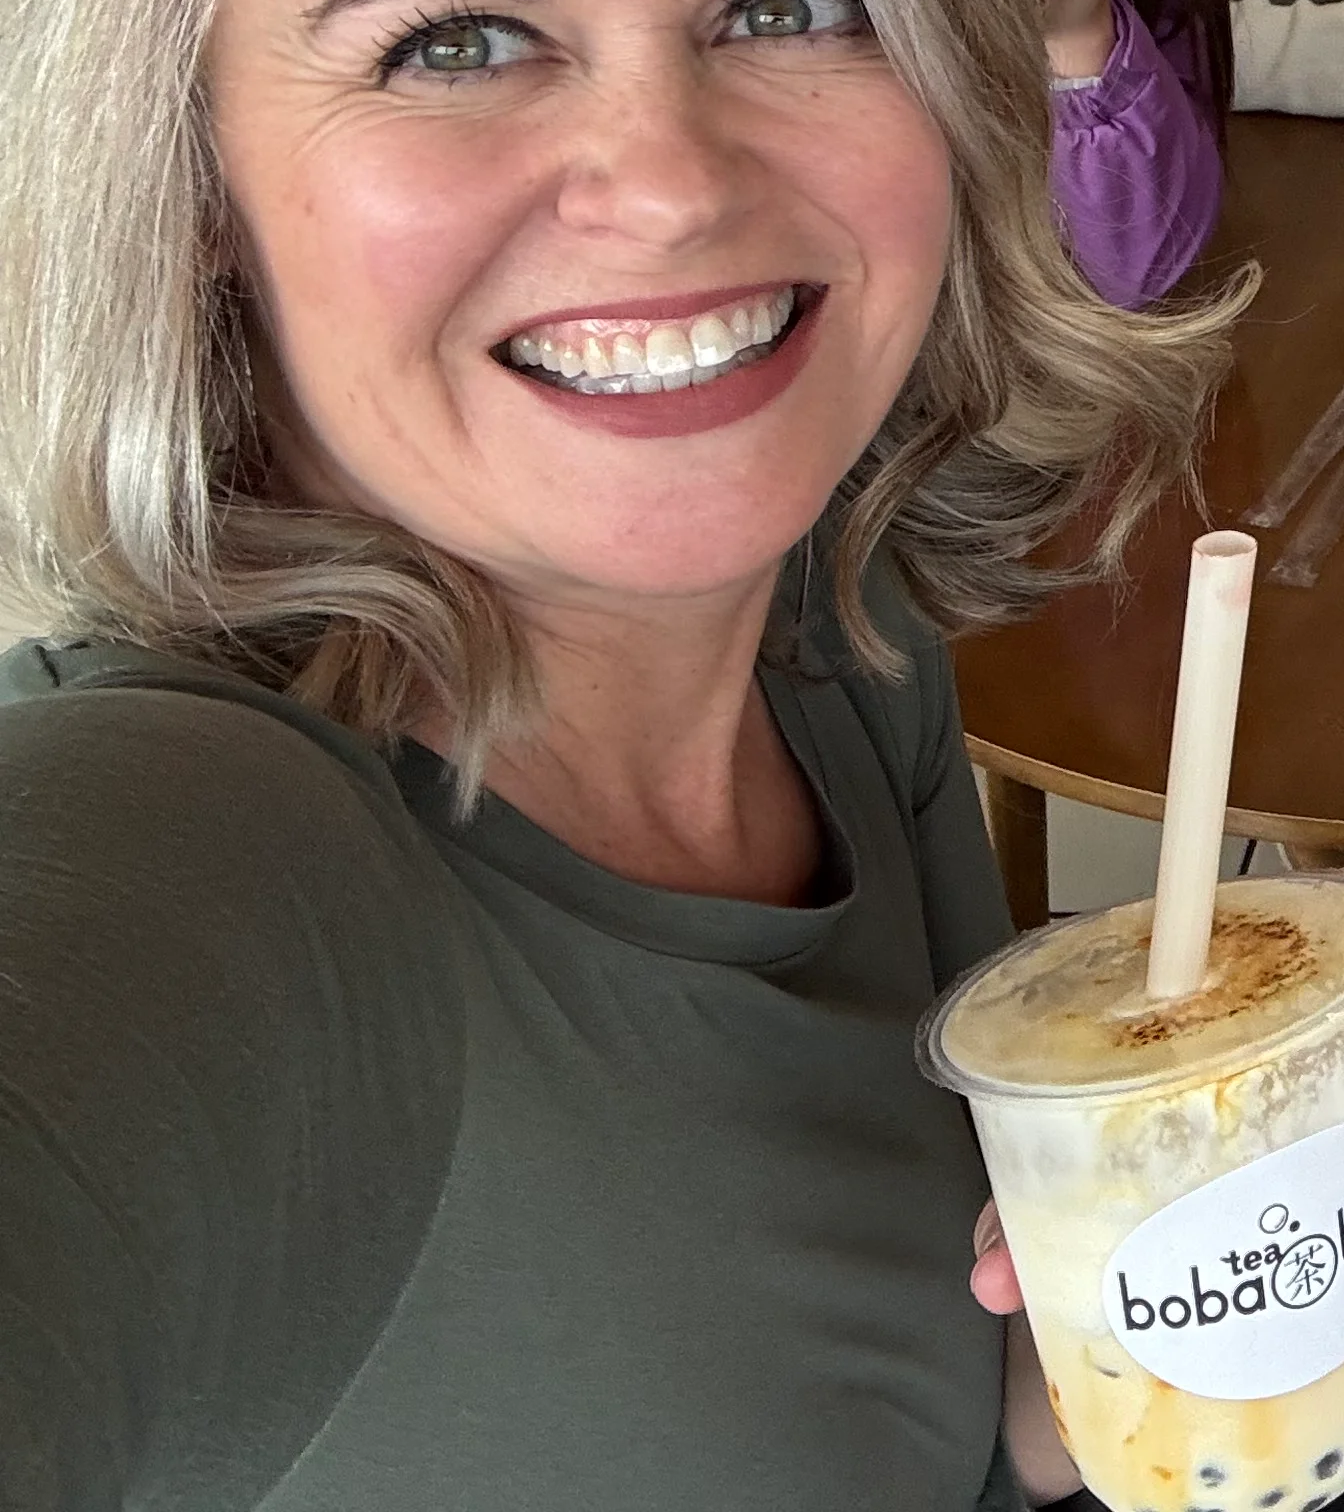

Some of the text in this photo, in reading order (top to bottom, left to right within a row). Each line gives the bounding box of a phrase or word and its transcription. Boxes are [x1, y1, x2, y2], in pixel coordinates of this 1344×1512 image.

[1117, 1264, 1267, 1331] boba
[1284, 1243, 1326, 1303] 茶
[1219, 1242, 1284, 1276] tea
